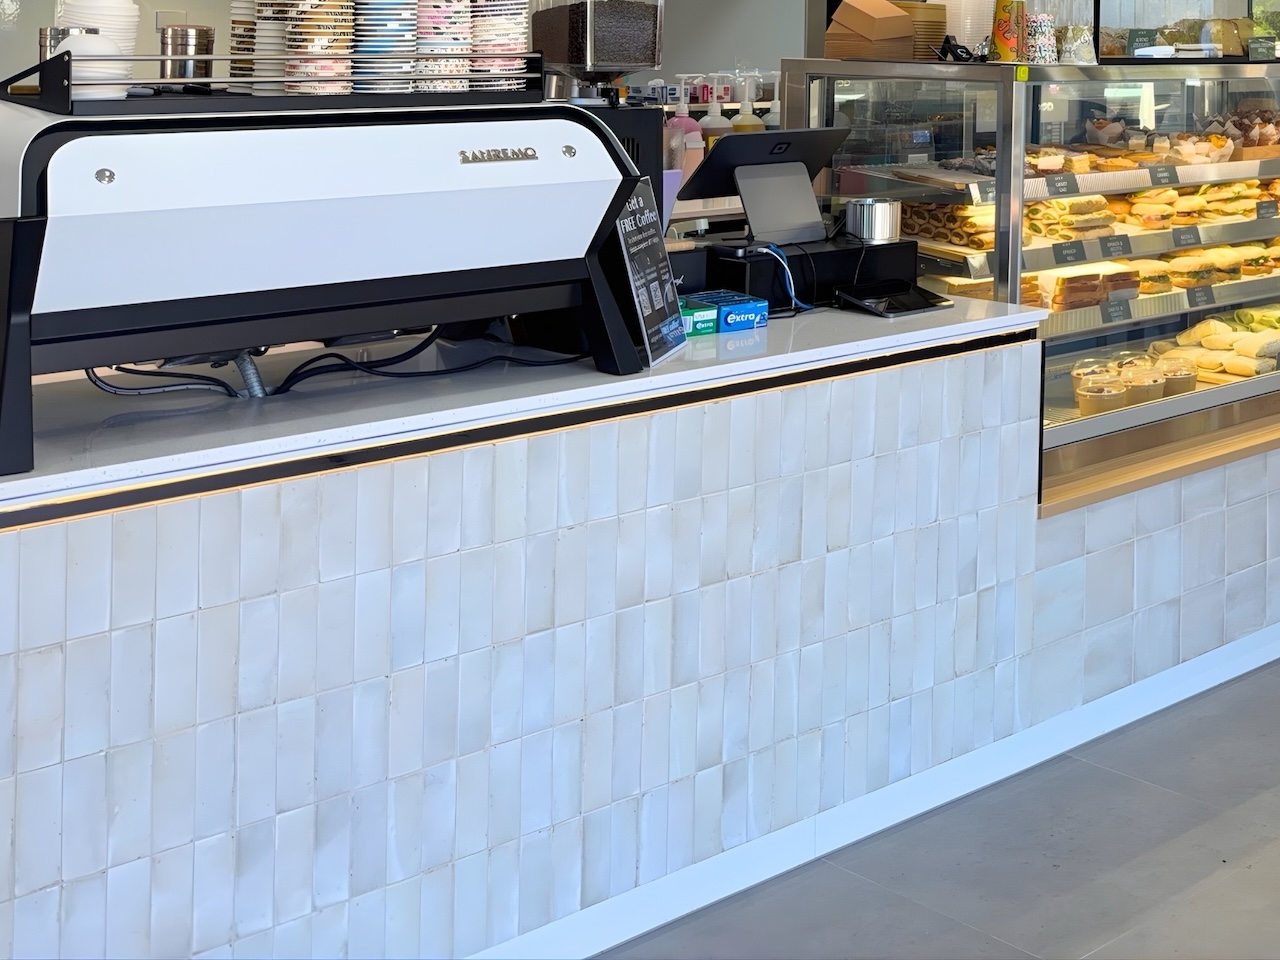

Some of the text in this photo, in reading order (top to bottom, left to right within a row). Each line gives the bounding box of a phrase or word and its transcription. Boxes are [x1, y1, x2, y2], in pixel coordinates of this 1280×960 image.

[458, 147, 538, 164] SANREMO
[620, 209, 657, 234] FREE Coffee
[727, 312, 755, 324] extra
[696, 322, 713, 330] extra
